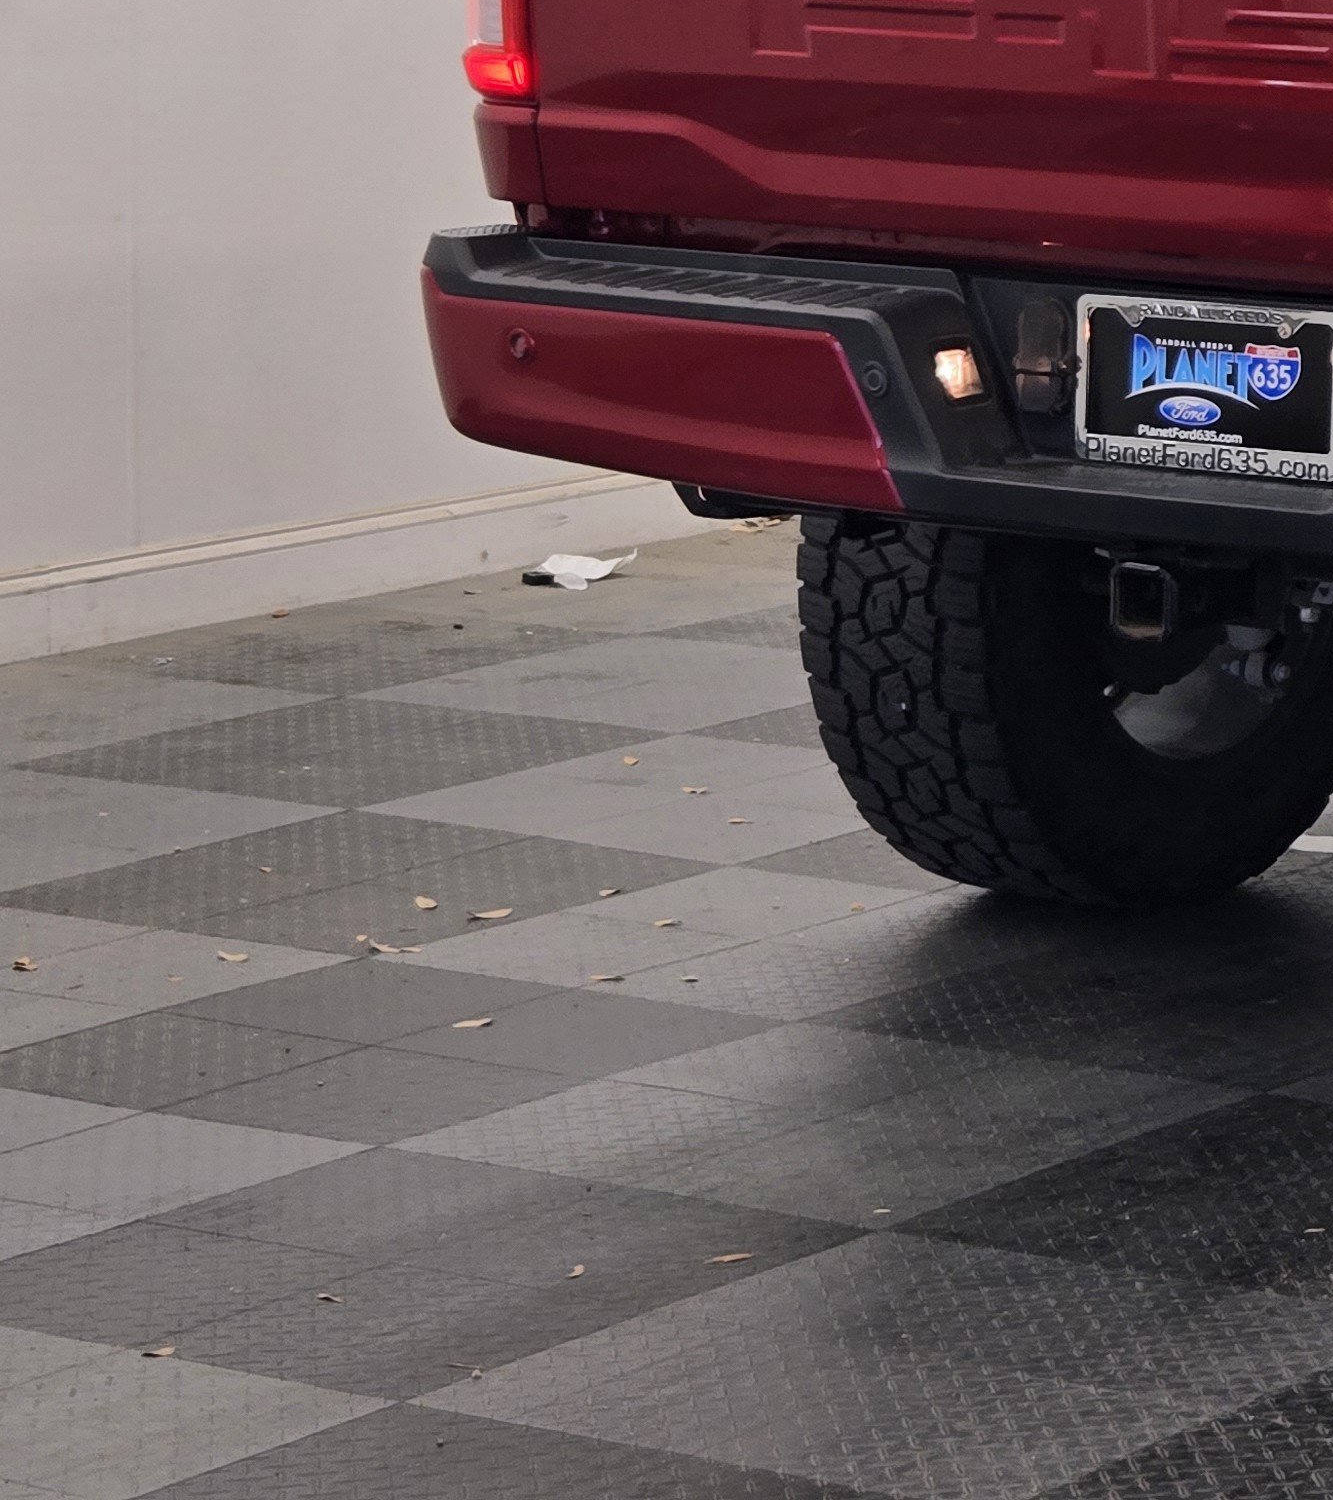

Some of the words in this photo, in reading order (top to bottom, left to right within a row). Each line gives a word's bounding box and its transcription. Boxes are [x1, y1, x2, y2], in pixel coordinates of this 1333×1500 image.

[1131, 333, 1253, 401] PLANET
[1253, 363, 1292, 390] 635
[1169, 401, 1210, 422] Ford
[1137, 423, 1243, 445] PlanetFord635.com
[1084, 436, 1329, 480] PlanetFord635.com
